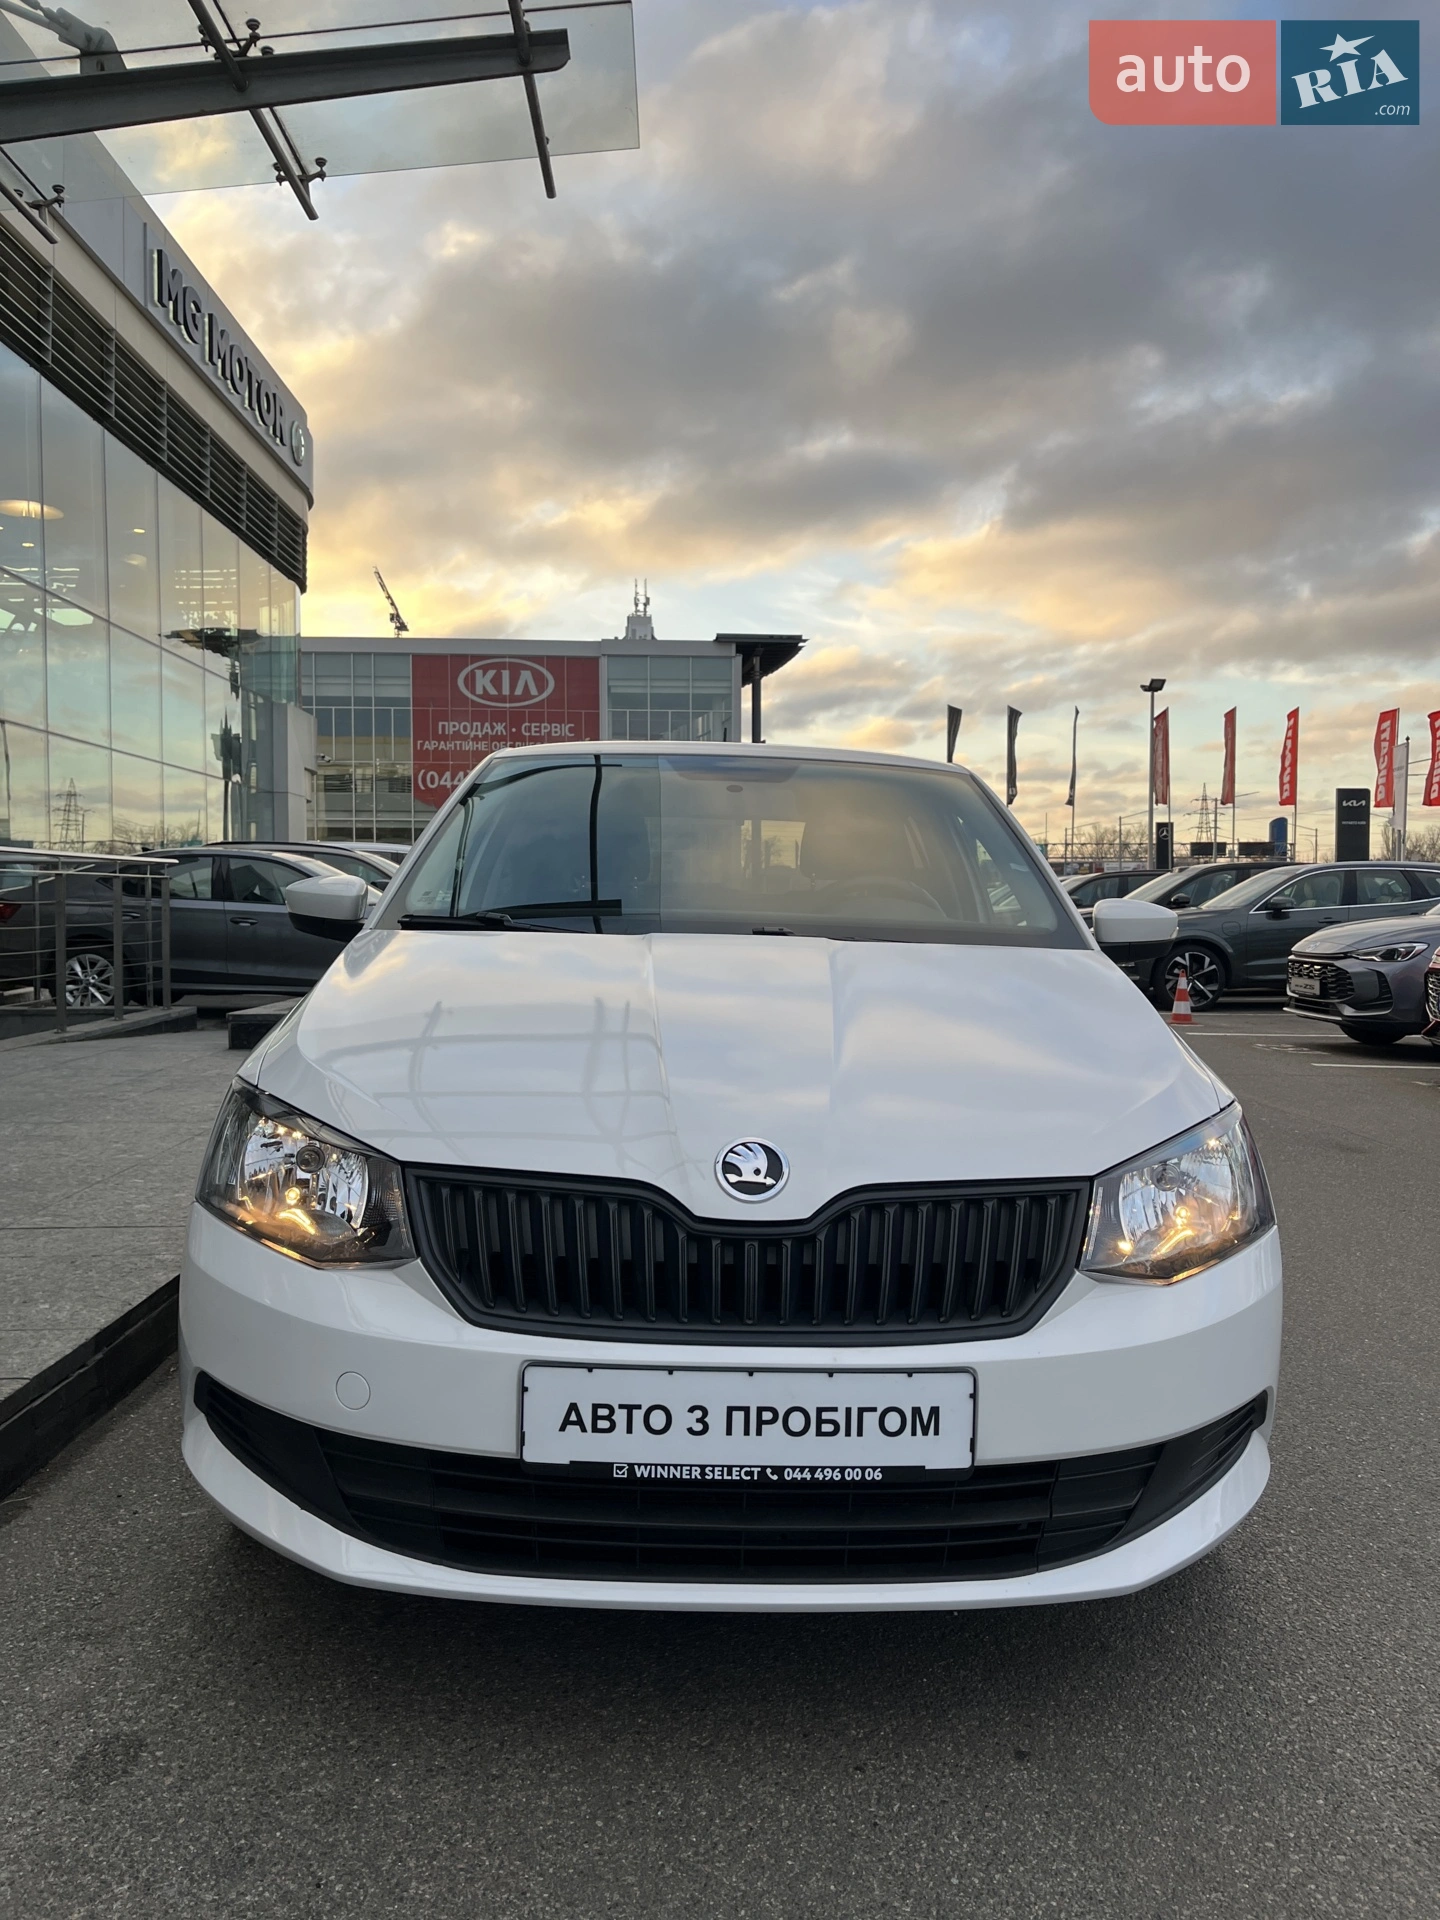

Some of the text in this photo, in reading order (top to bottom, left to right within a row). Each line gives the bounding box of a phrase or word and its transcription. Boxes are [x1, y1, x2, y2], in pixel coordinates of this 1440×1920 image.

[153, 249, 287, 447] MG MOTOR
[475, 669, 539, 696] KIA
[438, 721, 575, 738] ПРОДАЖ СЕРВІС
[417, 739, 488, 751] ГАРАНТІЙНЕ
[558, 1402, 941, 1438] АВТО З ПРОБІГОМ
[634, 1464, 882, 1481] WINNER SELECT 044 496 00 06
